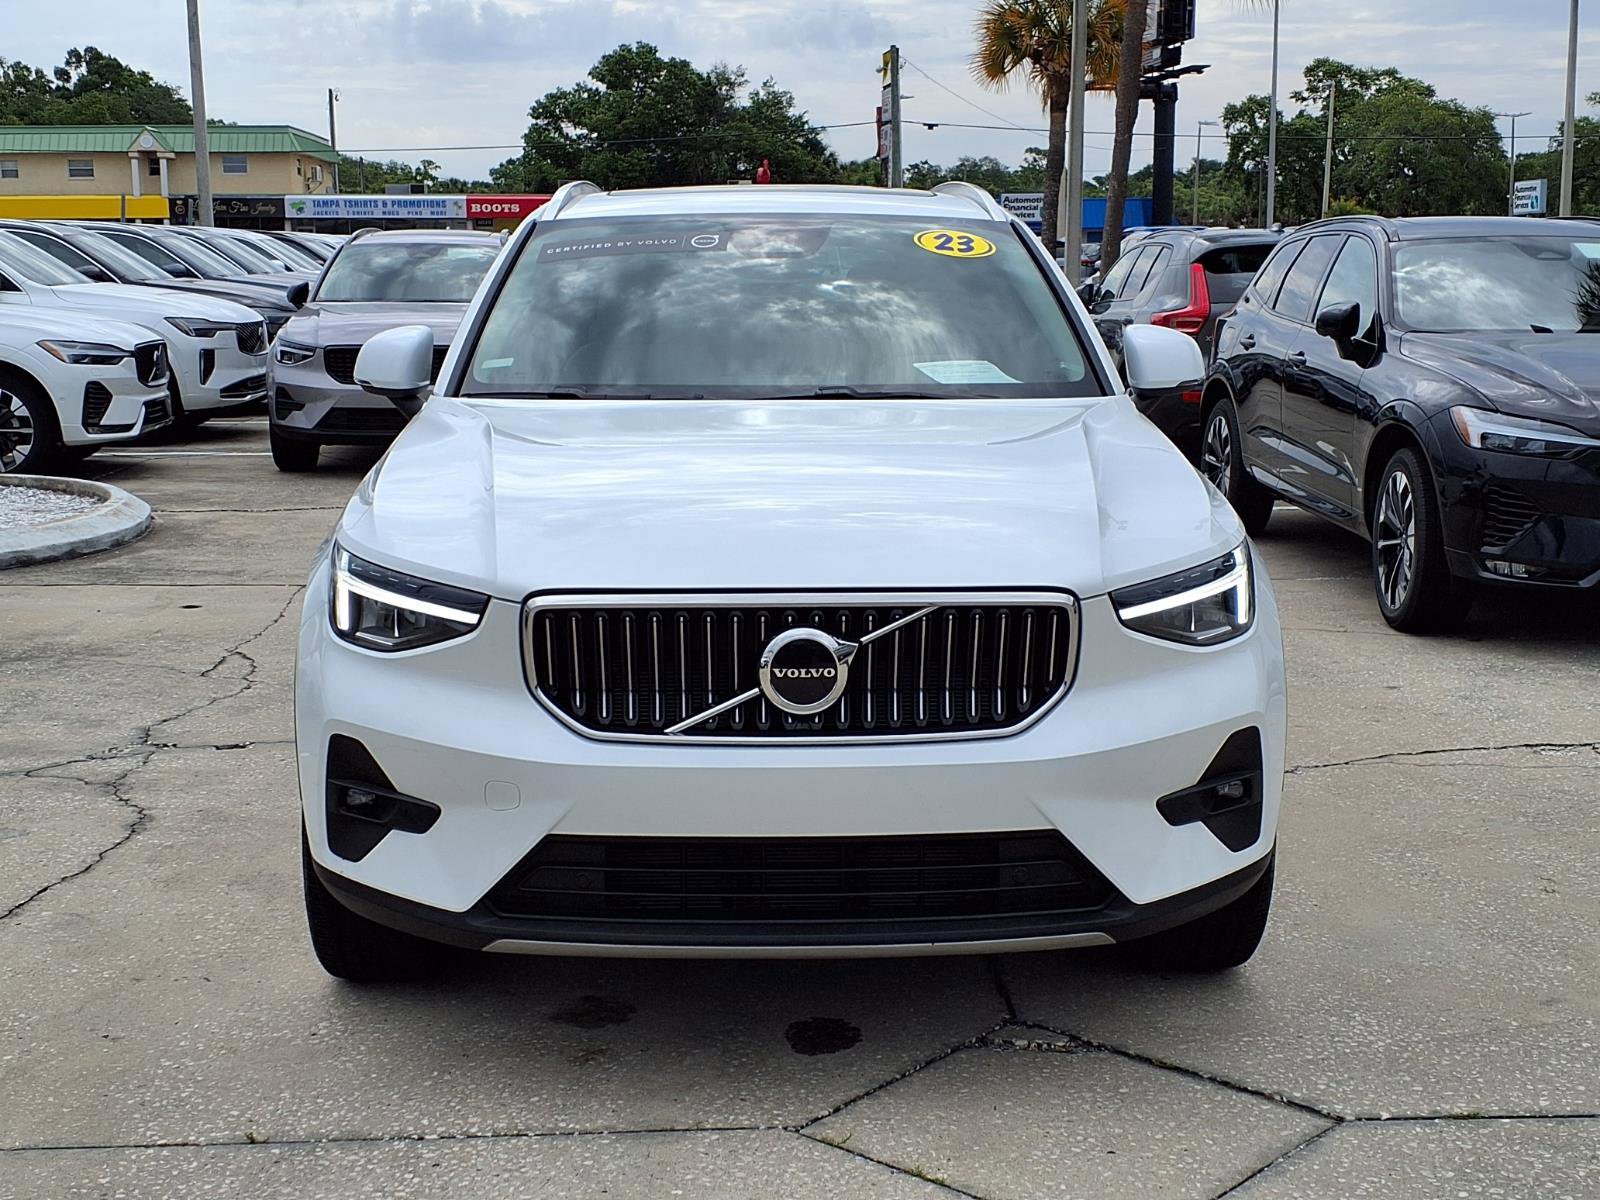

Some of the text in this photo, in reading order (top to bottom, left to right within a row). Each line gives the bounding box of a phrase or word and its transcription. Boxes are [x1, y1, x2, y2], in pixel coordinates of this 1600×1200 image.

[312, 200, 447, 208] TAMPA TSHIRTS & PROMOTIONS
[1003, 196, 1044, 204] Automoti
[471, 203, 520, 213] BOOTS
[933, 233, 975, 253] 23
[546, 243, 611, 254] CERTIFIED
[772, 667, 836, 678] VOLVO
